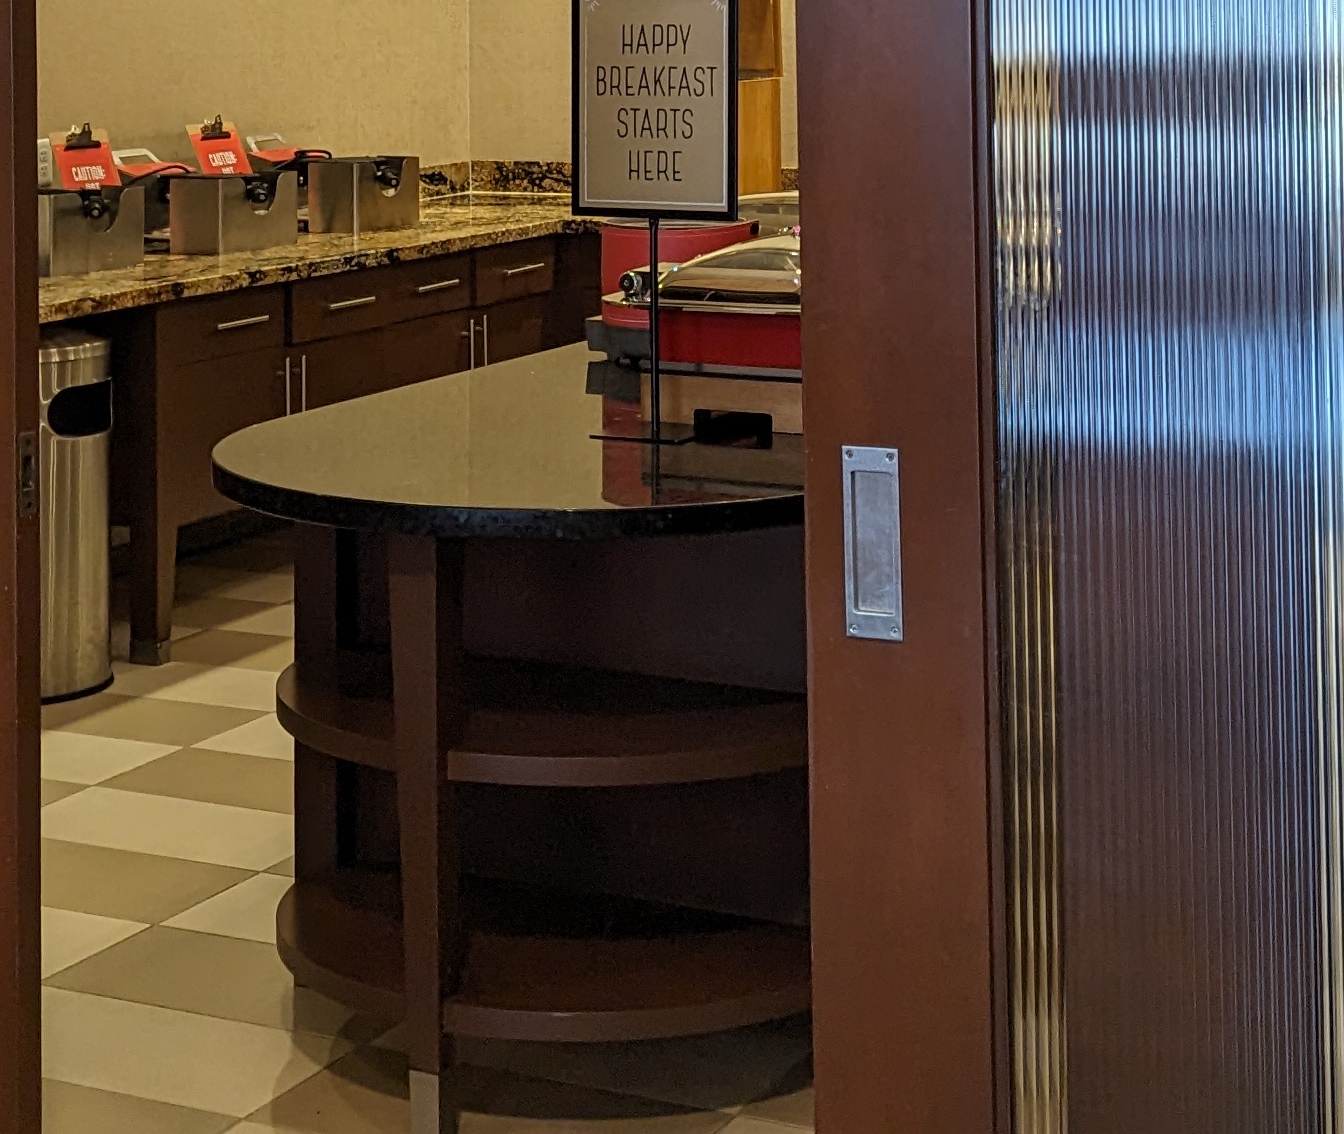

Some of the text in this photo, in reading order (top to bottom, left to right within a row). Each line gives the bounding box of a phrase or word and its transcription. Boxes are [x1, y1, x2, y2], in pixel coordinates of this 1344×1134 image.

[621, 23, 692, 55] HAPPY
[596, 65, 718, 97] BREAKFAST
[616, 107, 694, 139] STARTS
[628, 150, 683, 182] HERE
